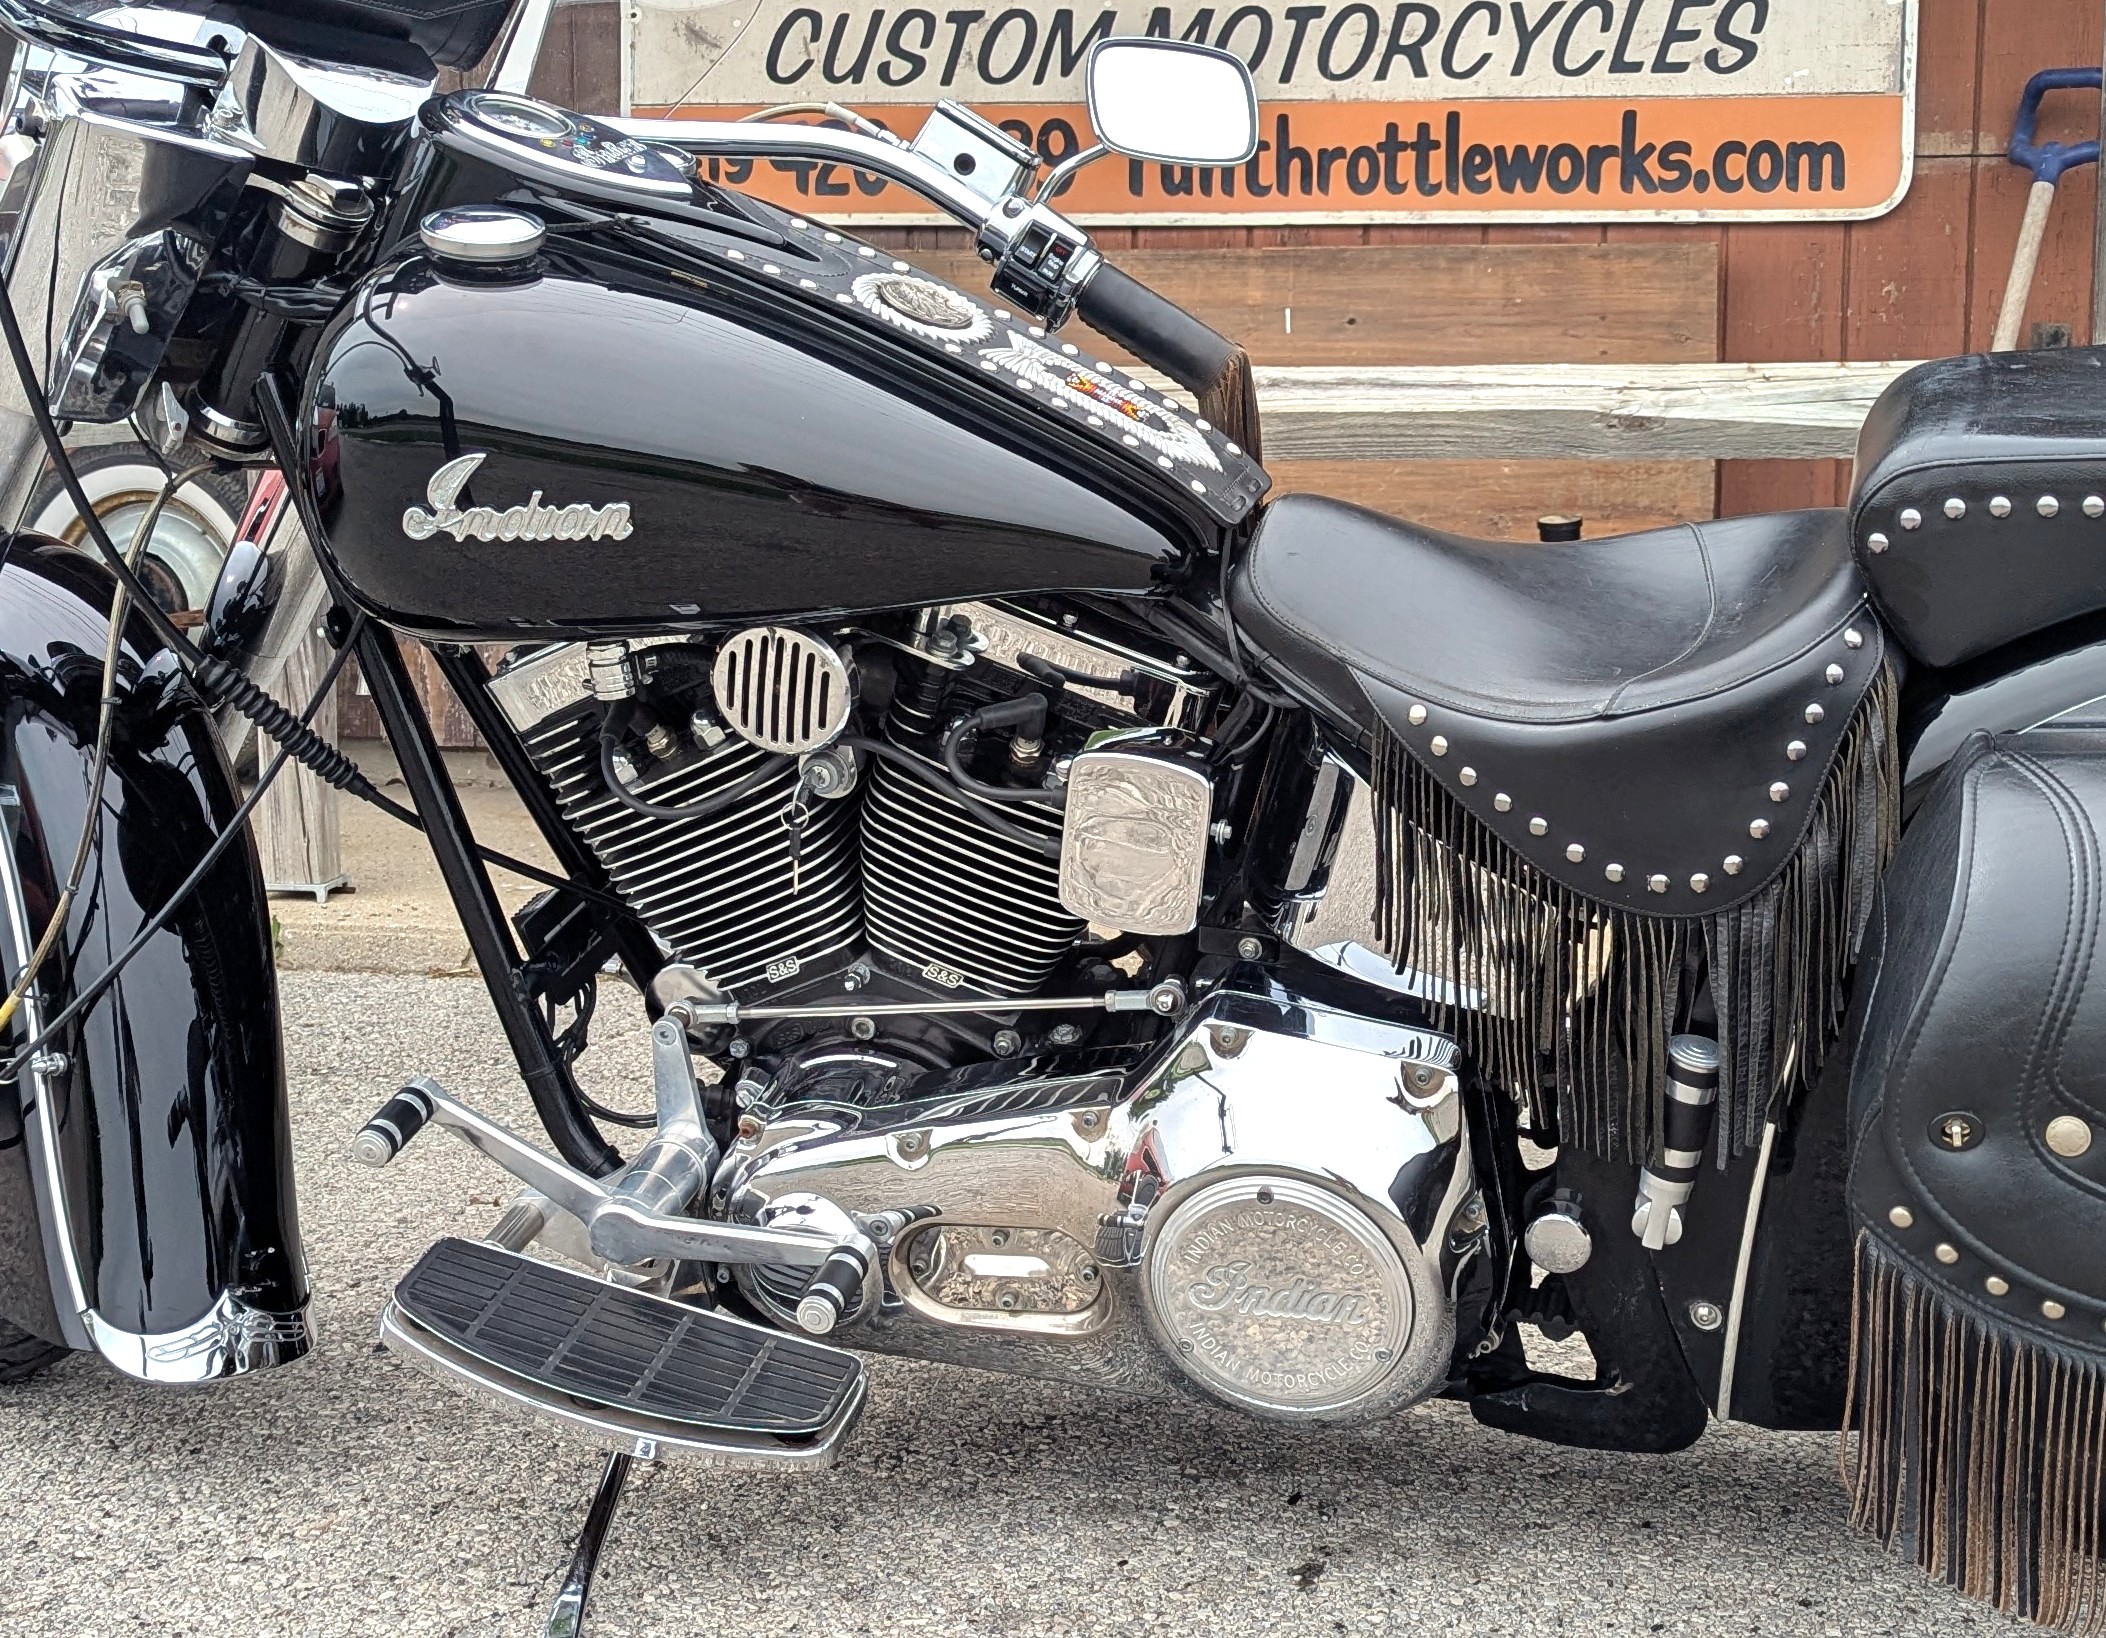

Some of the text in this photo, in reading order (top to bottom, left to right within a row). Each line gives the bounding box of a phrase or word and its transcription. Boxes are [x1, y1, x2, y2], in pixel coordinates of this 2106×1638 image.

[765, 6, 1118, 86] CUSTOM
[402, 453, 635, 542] Indian
[769, 959, 796, 979] S&S
[928, 966, 960, 986] S&S
[1184, 1218, 1234, 1264] INDIAN
[1238, 1210, 1347, 1255] MOTORCYCLE
[1188, 1260, 1367, 1325] Indian
[1189, 1322, 1240, 1372] INDIAN
[1246, 1357, 1353, 1389] MOTORCYCLE
